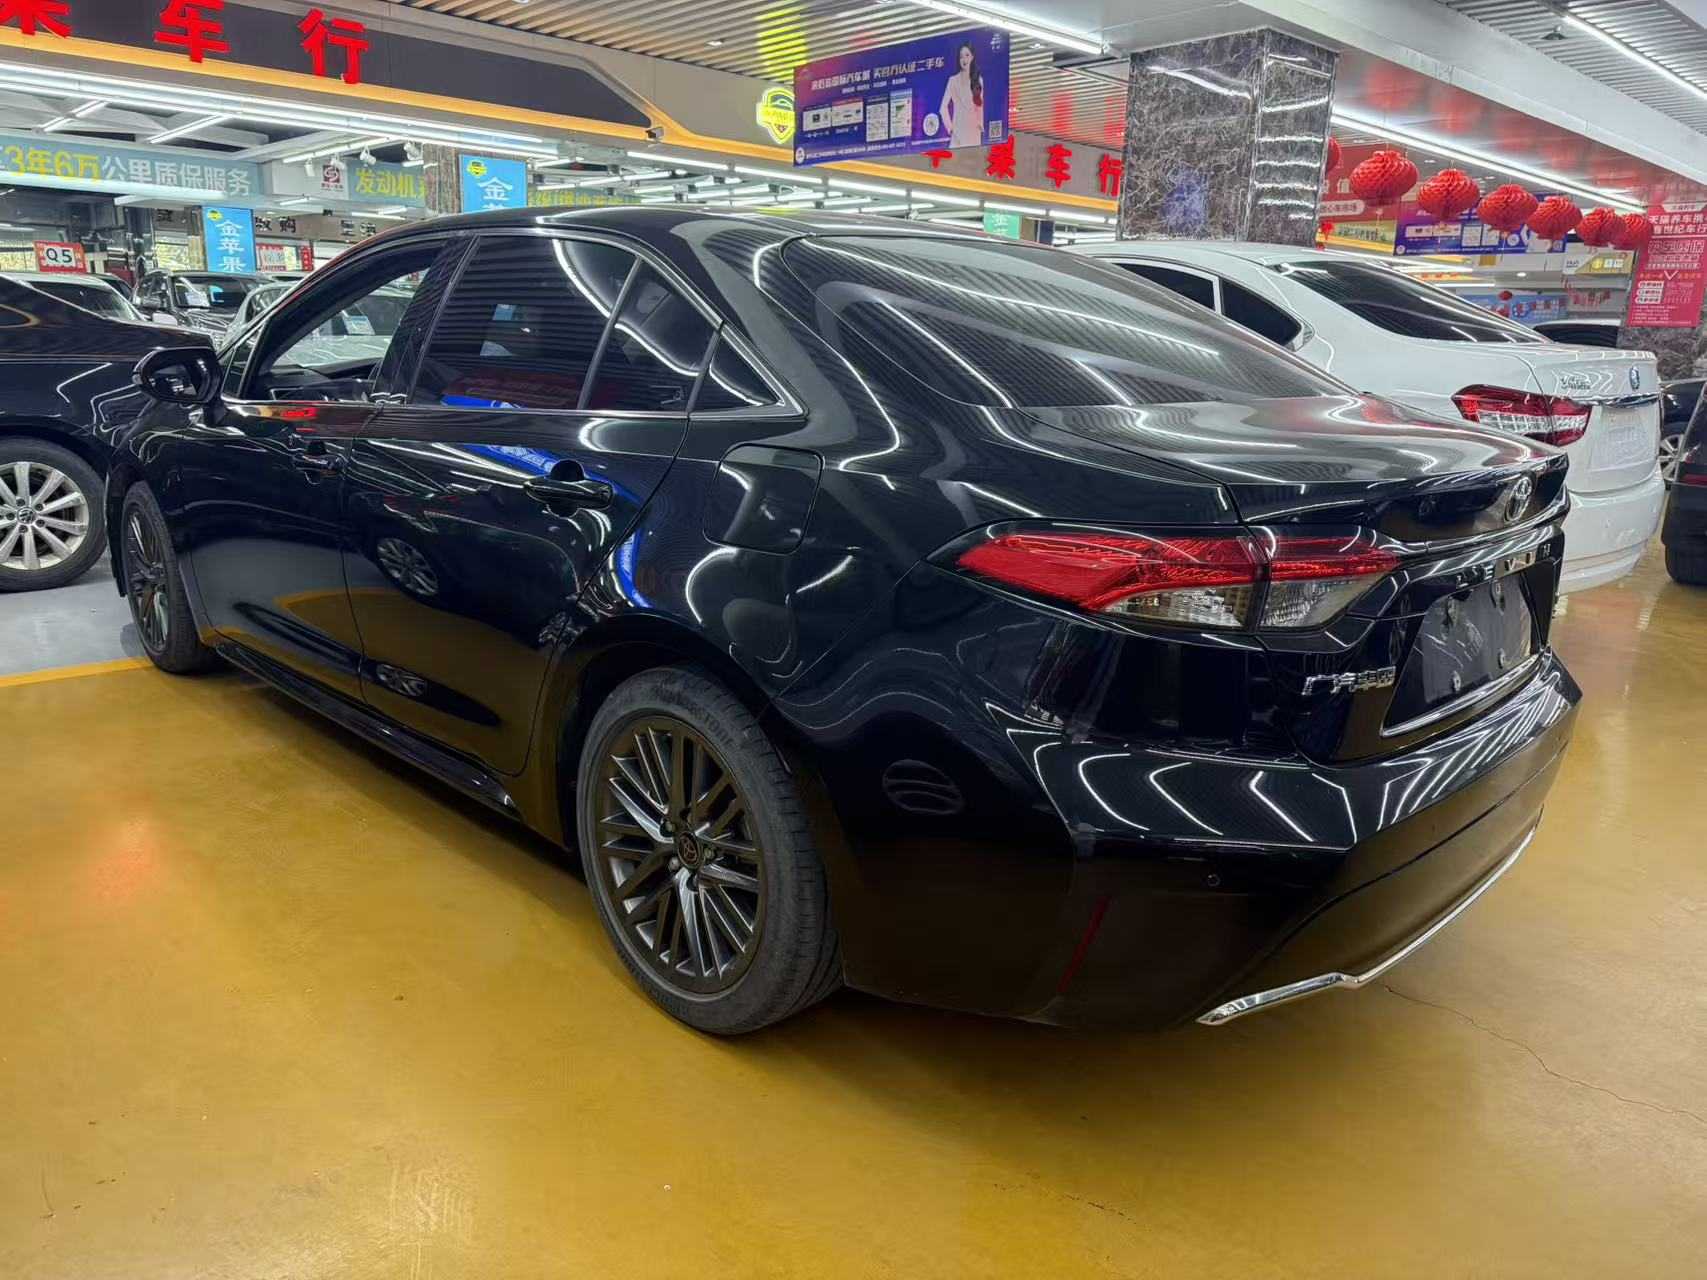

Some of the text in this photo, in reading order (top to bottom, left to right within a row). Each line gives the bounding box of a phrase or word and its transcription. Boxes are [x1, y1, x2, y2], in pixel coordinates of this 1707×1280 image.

[0, 145, 251, 196] 3年6万公里质保服务
[46, 248, 72, 263] Q5
[215, 219, 247, 272] 金苹果
